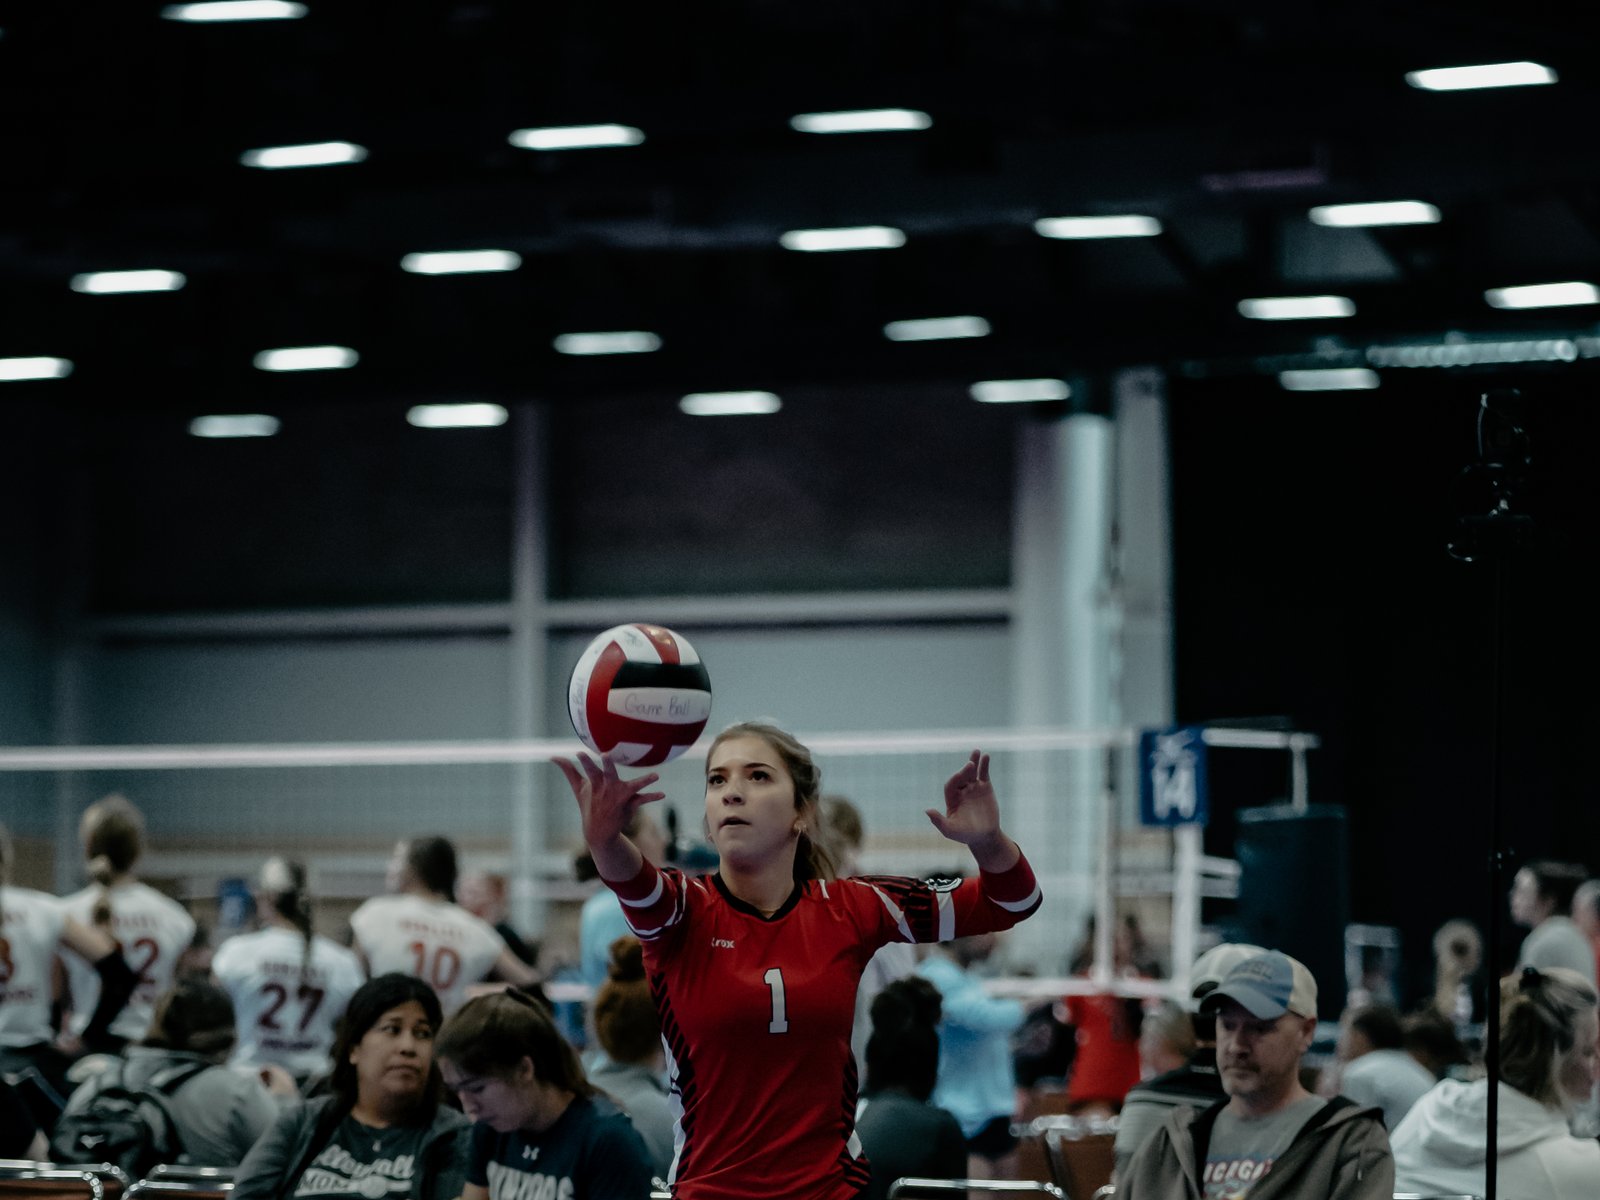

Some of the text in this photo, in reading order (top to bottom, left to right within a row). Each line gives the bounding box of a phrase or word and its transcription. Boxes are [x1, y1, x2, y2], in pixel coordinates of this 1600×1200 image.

[625, 693, 690, 717] Game Ball
[411, 942, 460, 990] 10
[259, 983, 324, 1031] 27
[763, 968, 789, 1034] 1
